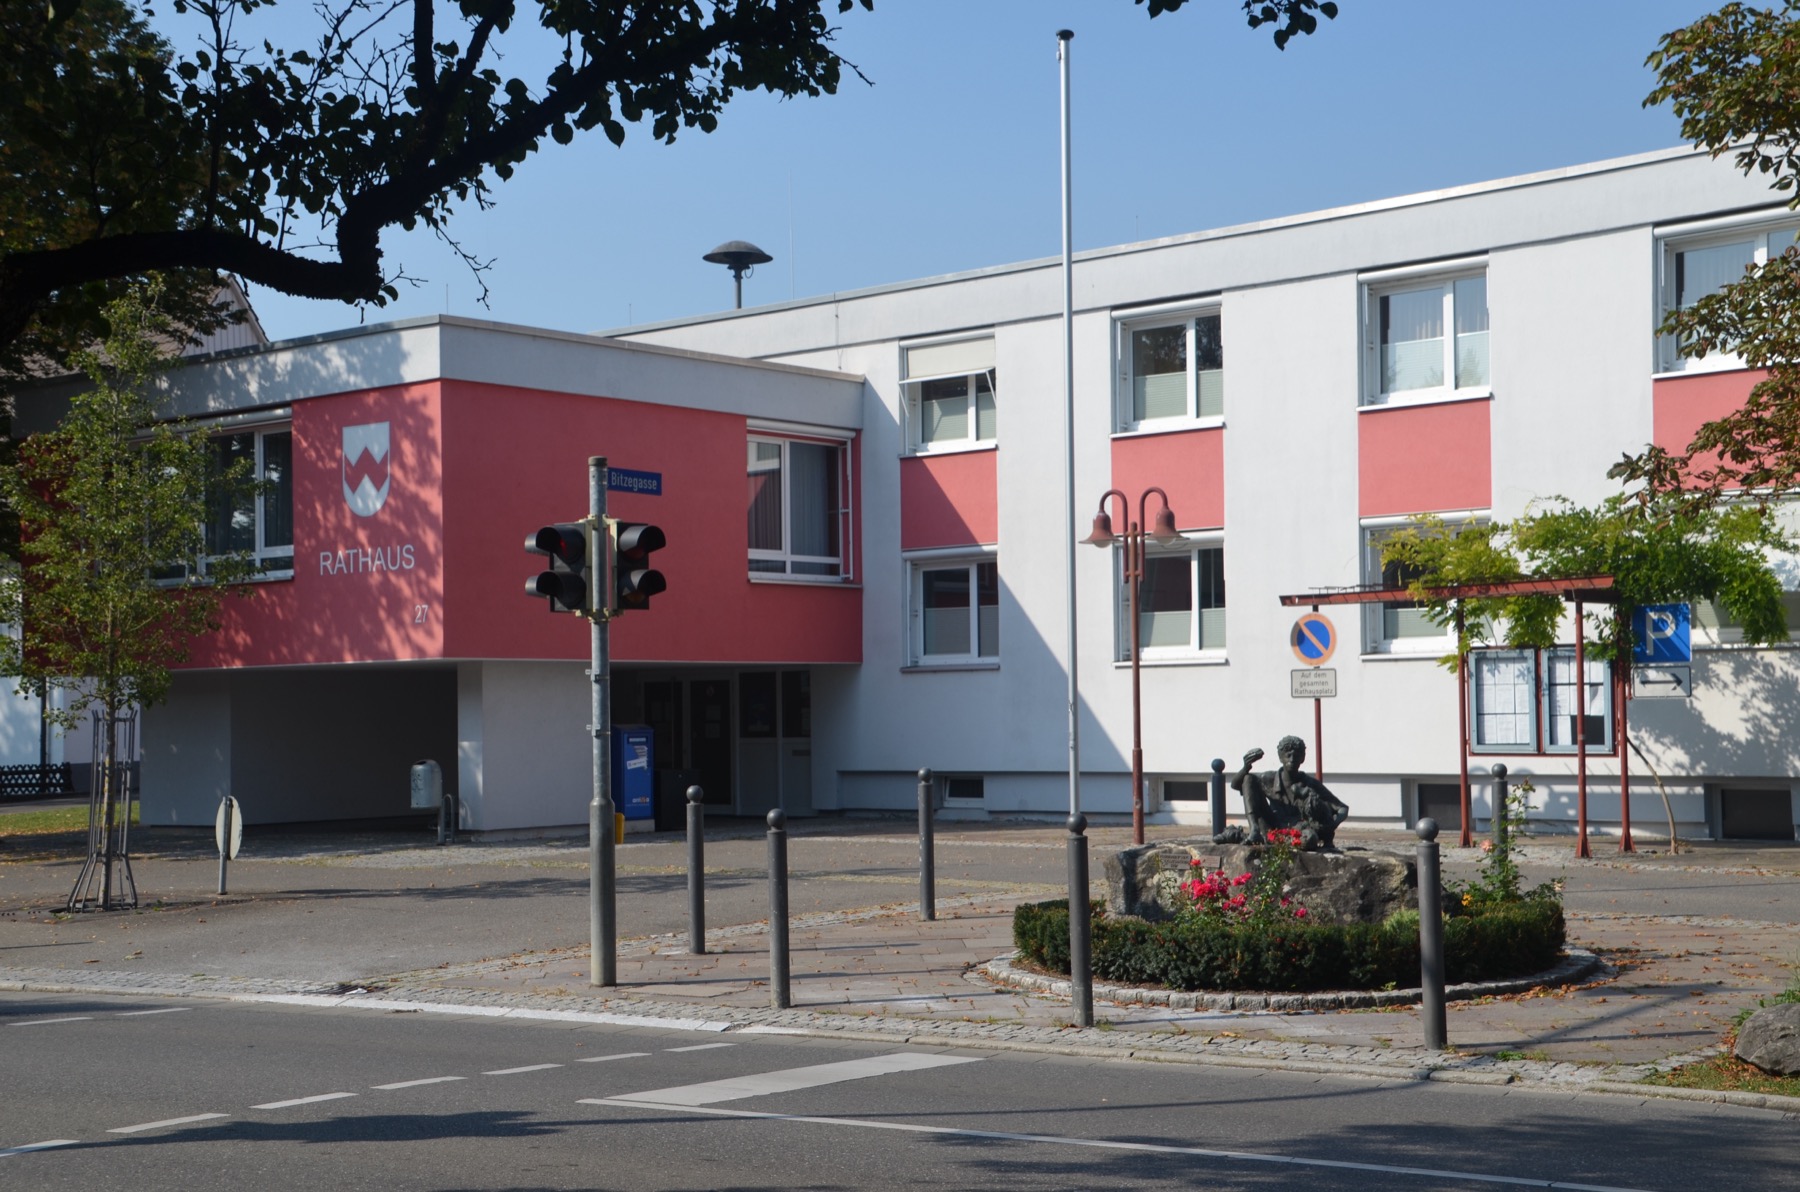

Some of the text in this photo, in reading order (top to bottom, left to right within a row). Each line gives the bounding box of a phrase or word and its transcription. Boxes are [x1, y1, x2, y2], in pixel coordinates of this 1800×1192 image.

[611, 471, 658, 491] Bitzegasse
[320, 544, 415, 576] RATHAUS
[414, 604, 429, 623] 27
[1646, 611, 1676, 656] P
[1299, 680, 1329, 688] gesamten
